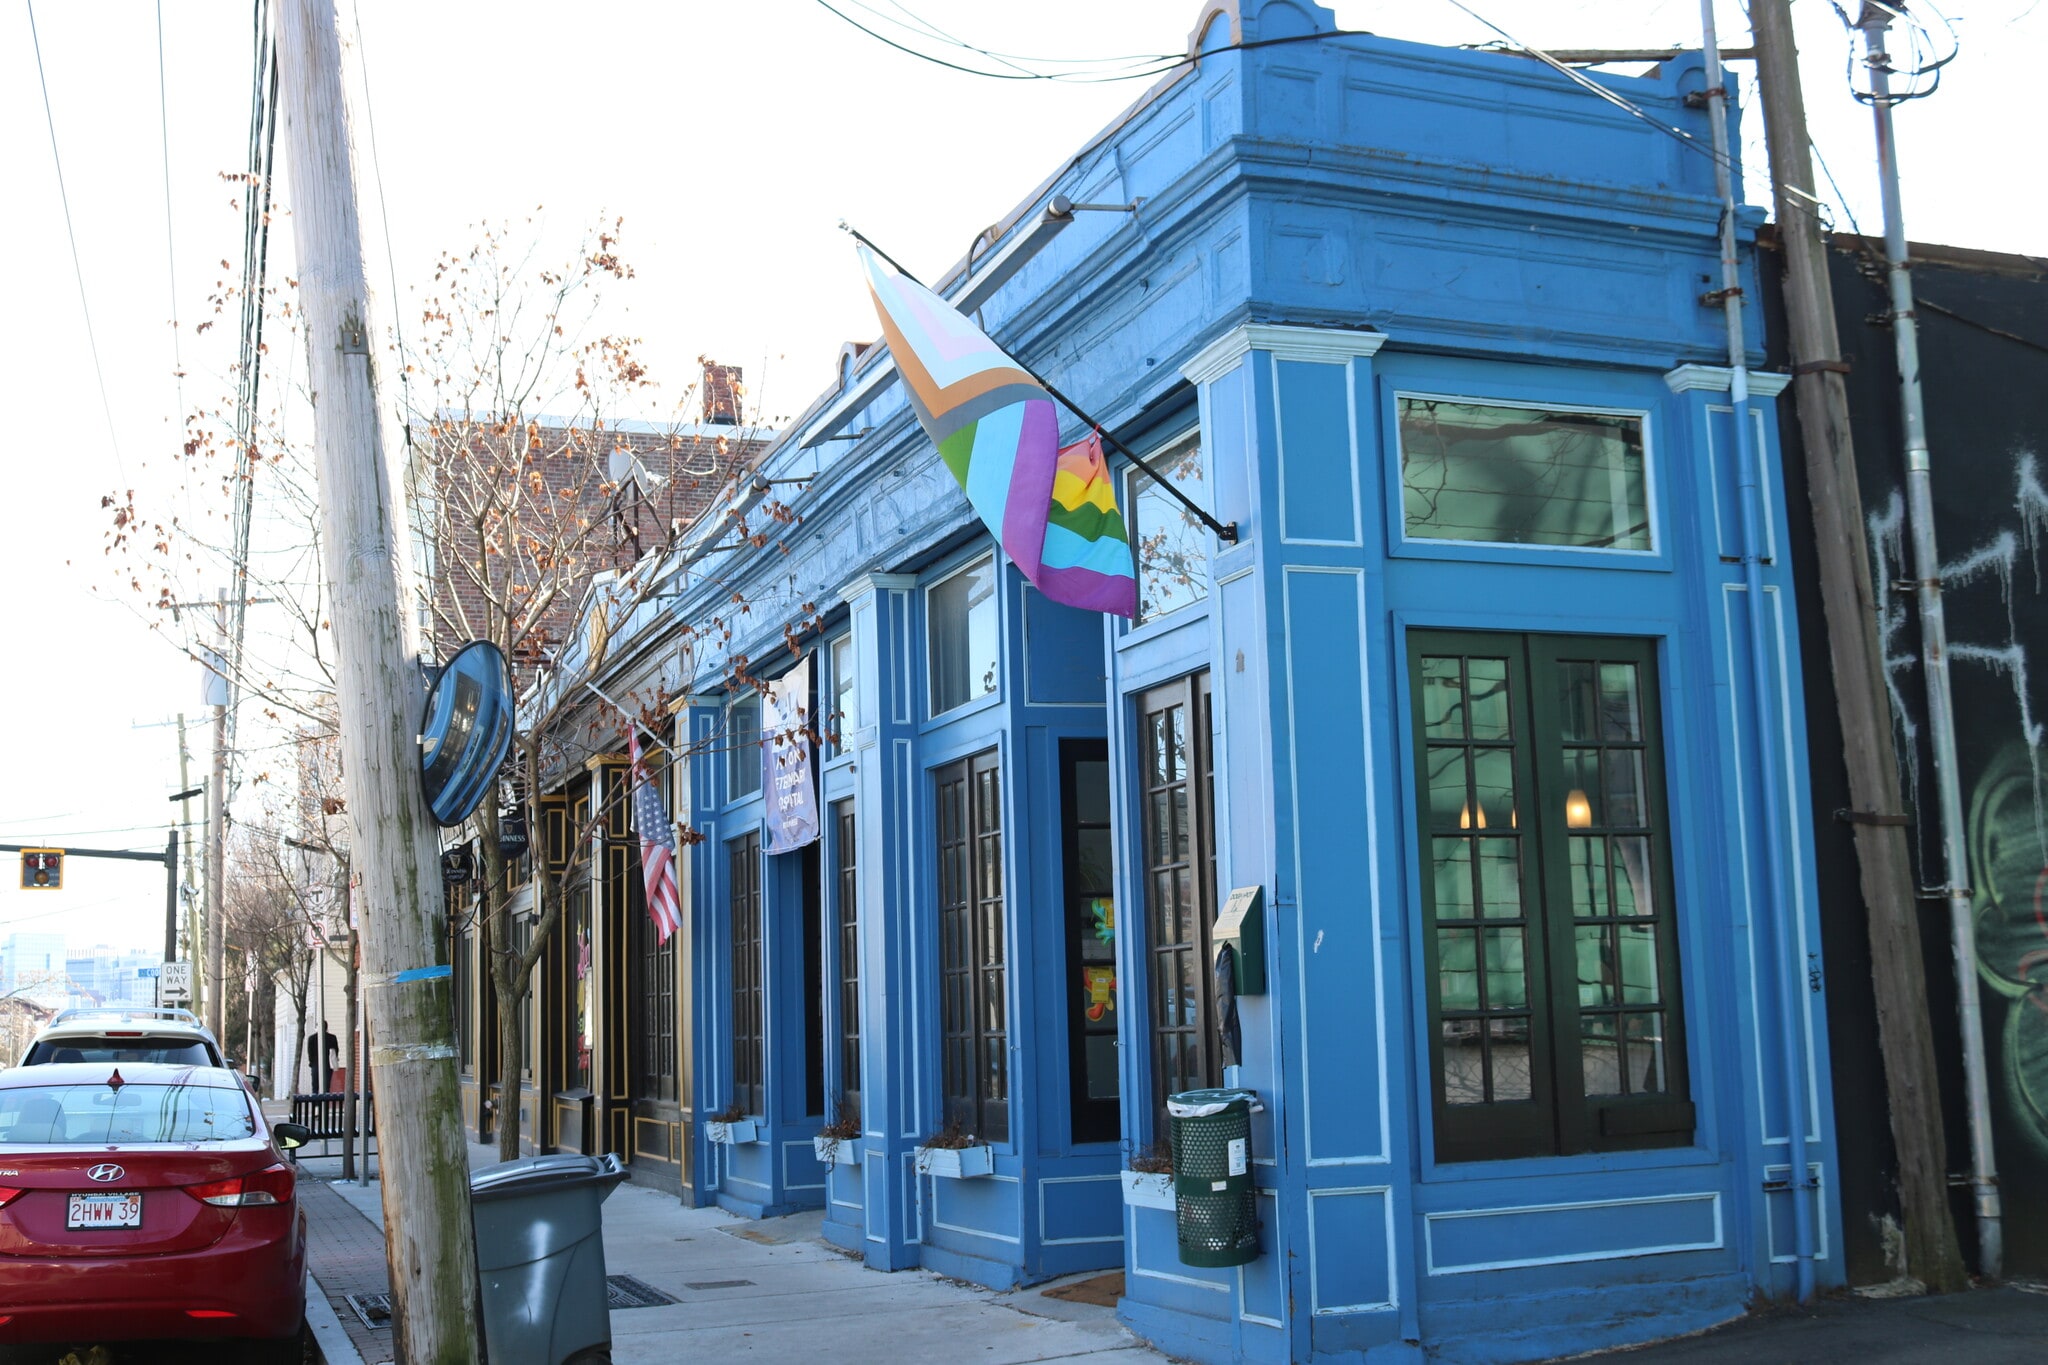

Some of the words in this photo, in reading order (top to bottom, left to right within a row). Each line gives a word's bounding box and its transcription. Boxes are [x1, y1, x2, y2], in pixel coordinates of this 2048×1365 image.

[499, 834, 526, 843] INNESS
[146, 968, 161, 977] COO
[166, 965, 187, 975] ONE
[166, 976, 188, 985] WAY
[71, 1203, 114, 1221] 2HWW
[118, 1202, 139, 1220] 39
